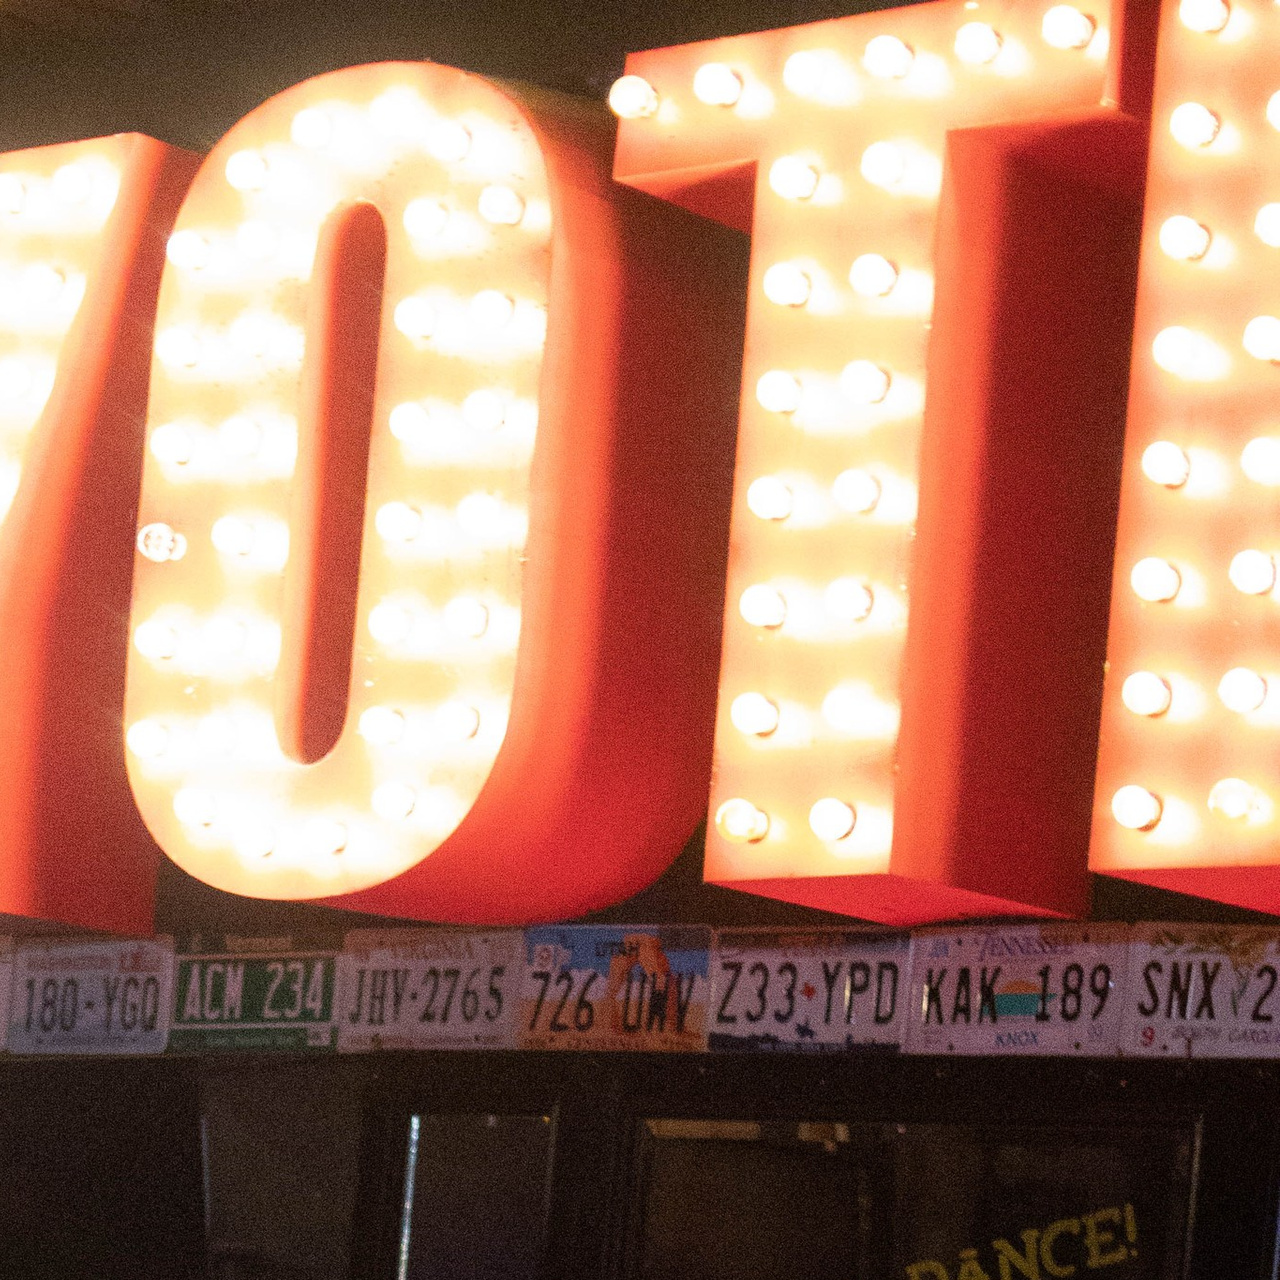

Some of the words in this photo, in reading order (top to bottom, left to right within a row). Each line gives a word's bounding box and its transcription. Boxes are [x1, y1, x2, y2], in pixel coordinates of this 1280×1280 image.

[263, 960, 325, 1019] 234
[528, 971, 599, 1032] 726
[717, 961, 799, 1024] Z33
[822, 961, 900, 1024] YPD
[925, 965, 1002, 1025] KAK
[1035, 962, 1113, 1023] 189
[1138, 960, 1222, 1020] SNX
